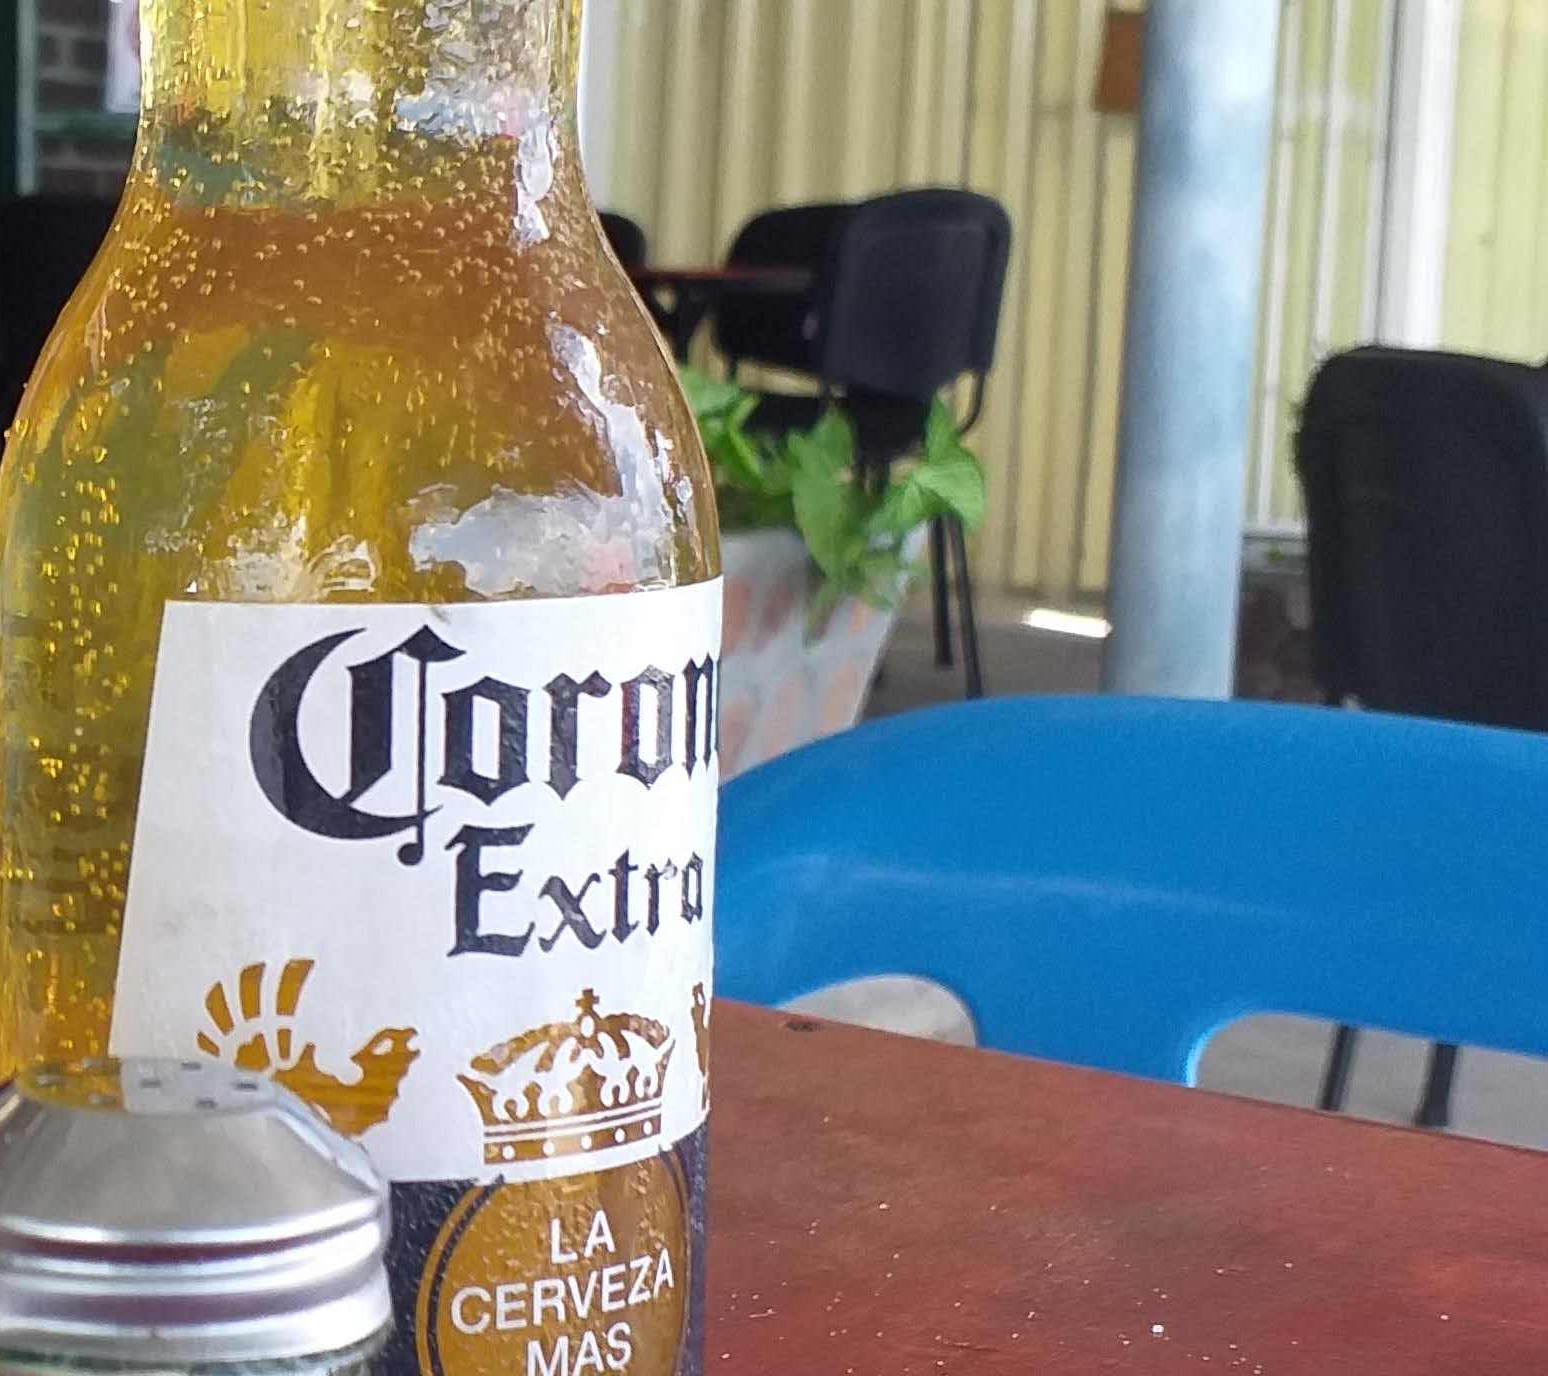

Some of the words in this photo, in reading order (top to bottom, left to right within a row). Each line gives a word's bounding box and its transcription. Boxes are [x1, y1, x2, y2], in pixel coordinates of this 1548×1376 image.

[250, 624, 716, 865] Coron
[445, 823, 703, 958] Extra
[451, 1248, 674, 1335] CERVEZA
[551, 1210, 615, 1264] LA
